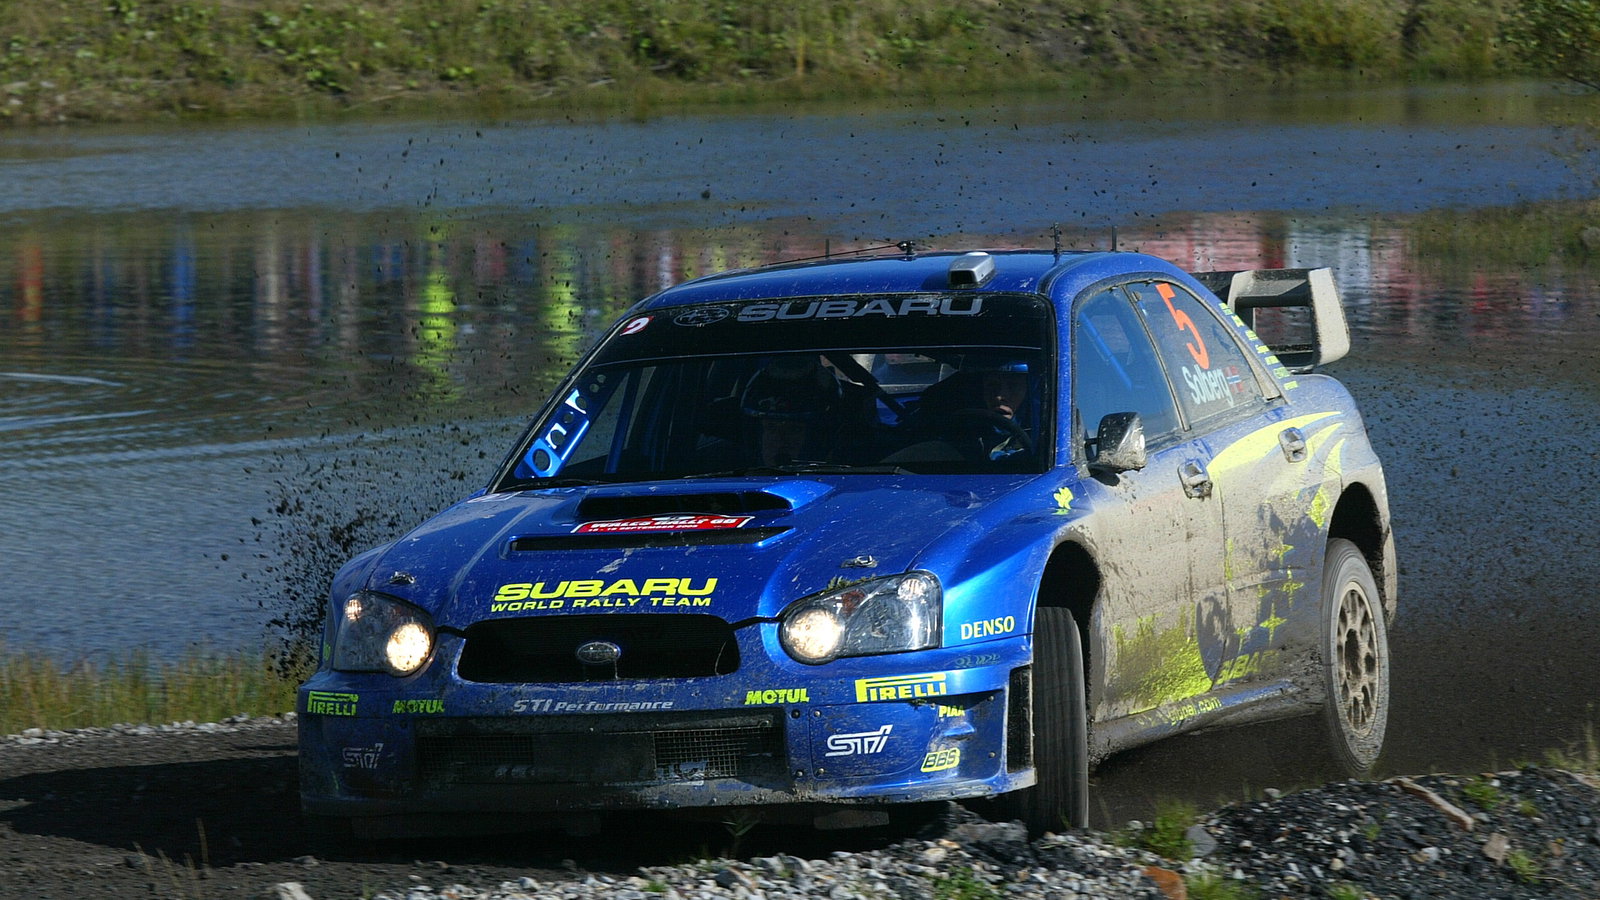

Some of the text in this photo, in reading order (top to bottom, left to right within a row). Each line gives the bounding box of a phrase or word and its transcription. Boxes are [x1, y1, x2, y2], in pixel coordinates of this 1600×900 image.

[737, 298, 983, 322] SUBARU
[1155, 283, 1210, 369] 5
[1181, 364, 1235, 408] Solberg
[494, 578, 718, 602] SUBARU
[491, 597, 711, 612] WORLD RALLY TEAM
[961, 616, 1015, 640] DENSO
[745, 688, 809, 704] MOTUL
[855, 673, 947, 703] PIRELLI
[307, 691, 359, 716] PIRELLI
[392, 699, 445, 714] MOTUL
[513, 699, 674, 713] STI Performance
[938, 705, 965, 718] PIAA
[920, 748, 961, 772] BBS
